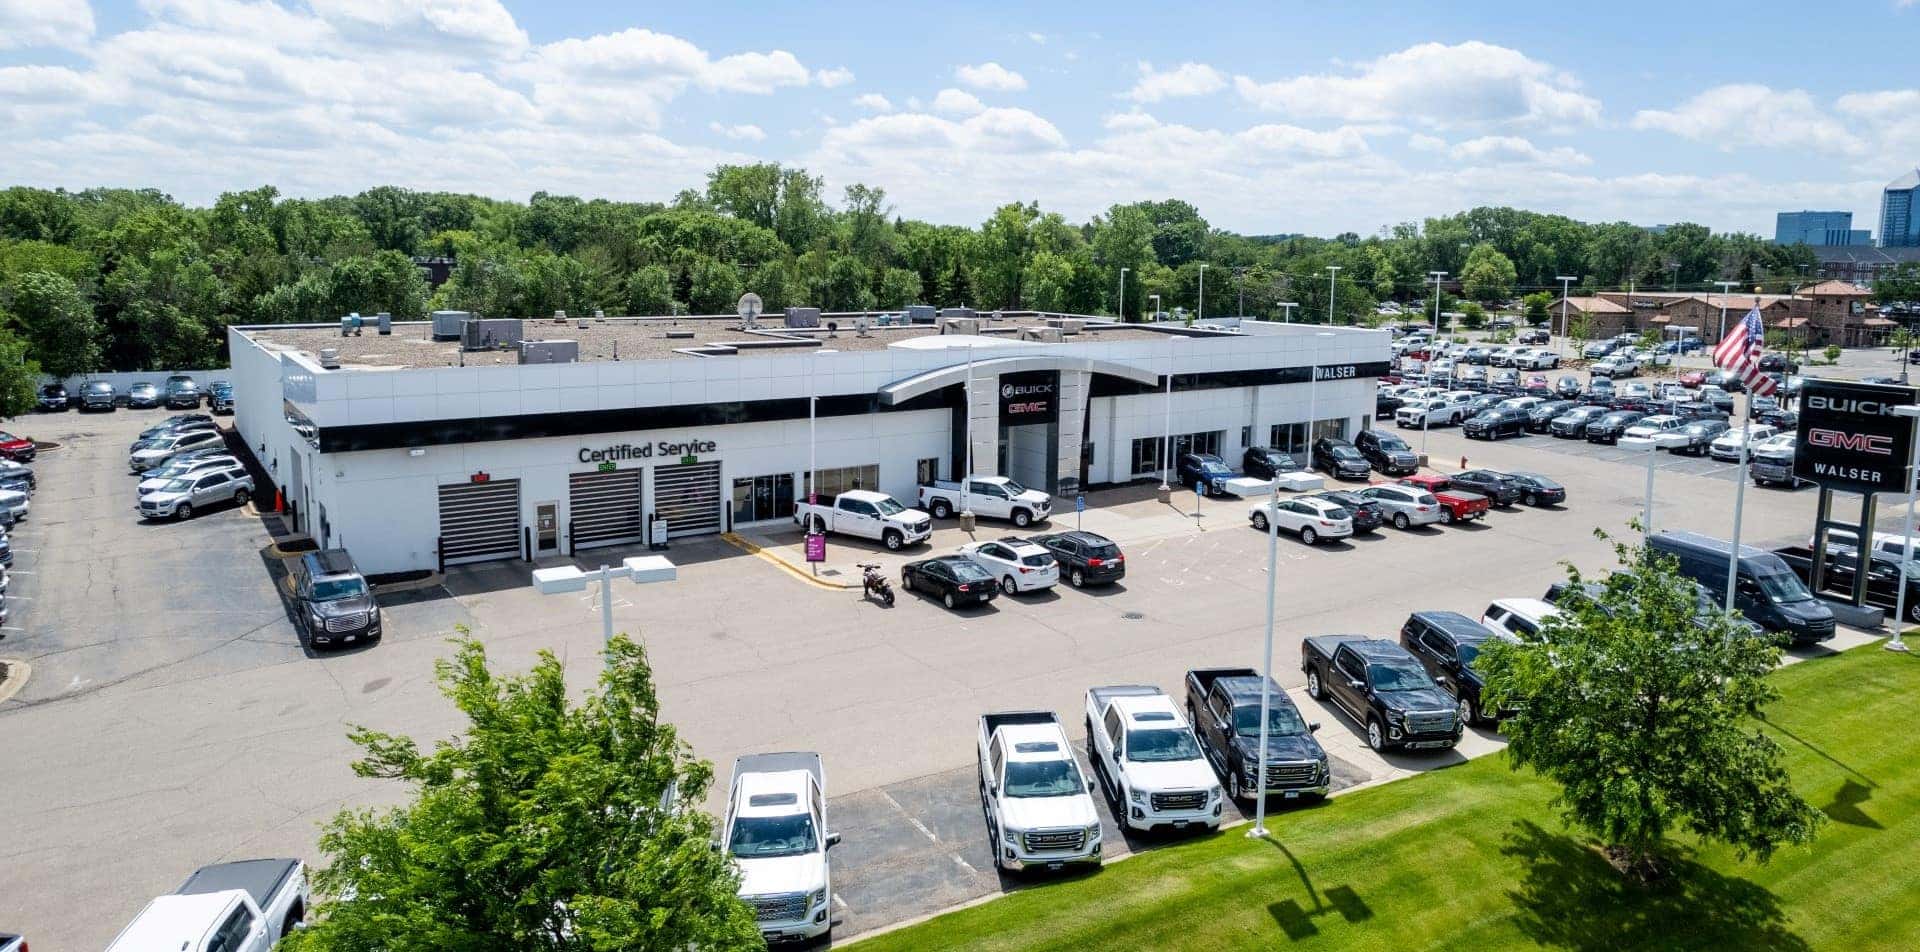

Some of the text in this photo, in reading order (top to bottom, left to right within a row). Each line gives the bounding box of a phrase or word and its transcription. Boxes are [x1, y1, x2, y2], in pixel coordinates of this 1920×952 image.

[1316, 366, 1356, 379] WALSER
[1015, 384, 1054, 394] BUICK
[1009, 401, 1047, 413] GMC
[1808, 395, 1898, 416] BUICK
[579, 439, 717, 463] Certified Service
[1809, 428, 1893, 455] GMC
[1814, 462, 1881, 483] WALSER
